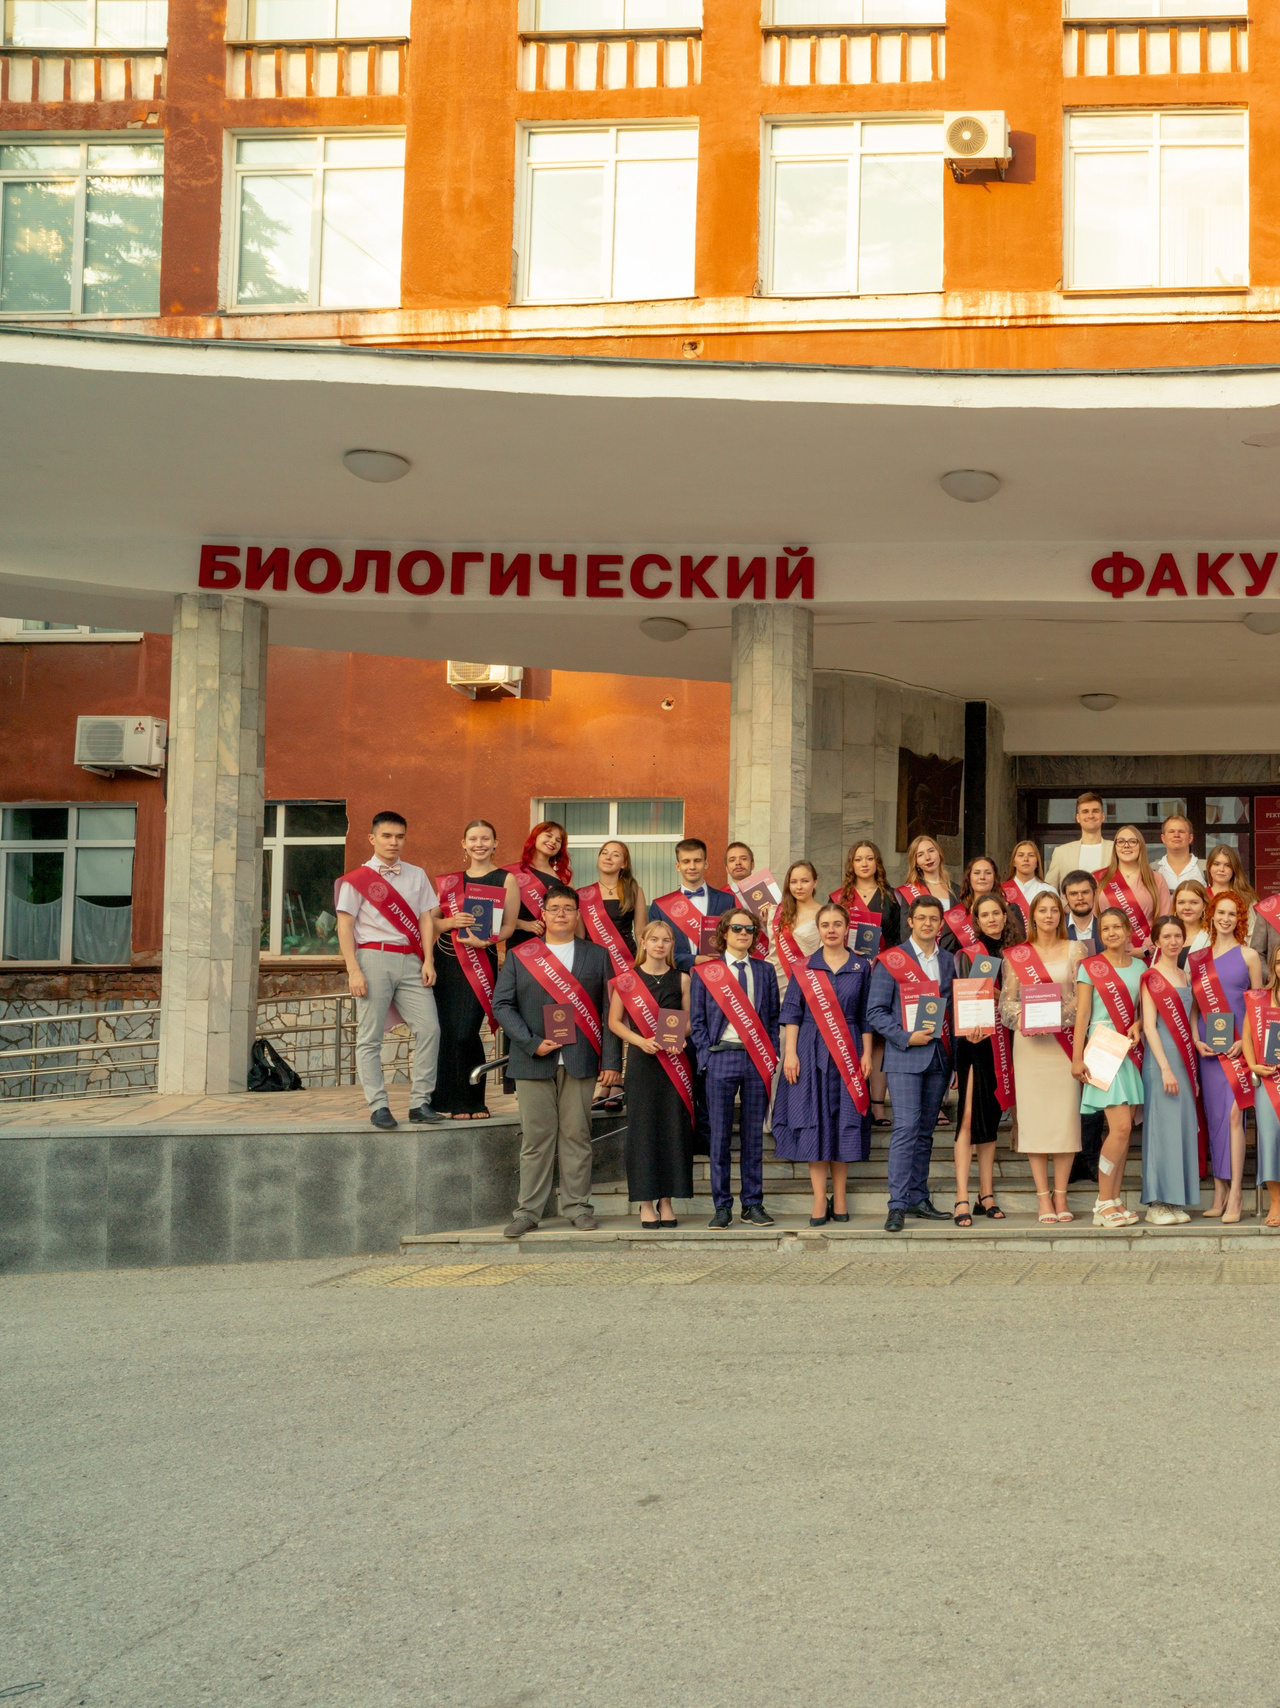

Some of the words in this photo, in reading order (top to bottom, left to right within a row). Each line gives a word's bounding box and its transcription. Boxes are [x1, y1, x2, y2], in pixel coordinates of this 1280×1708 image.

[198, 545, 817, 601] БИОЛОГИЧЕСКИЙ
[1110, 881, 1134, 917] ЛУЧШИЙ
[587, 905, 612, 948] ЛУЧШИЙ
[534, 956, 571, 993] ЛУЧШИЙ
[1198, 963, 1219, 1006] ЛУЧШИЙ
[632, 995, 657, 1033] ЛУЧШИ
[720, 985, 753, 1029] ЛУЧШИЙ
[1105, 981, 1130, 1027] ЛУЧШИЙ
[1163, 997, 1190, 1043] ЛУЧШИЙ
[805, 969, 831, 1011] ЛУЧШИЙ
[823, 1011, 856, 1075] ВЫПУСКНИК
[851, 1075, 864, 1097] 2024
[1002, 1073, 1010, 1096] 2024
[1237, 1072, 1251, 1094] 2024
